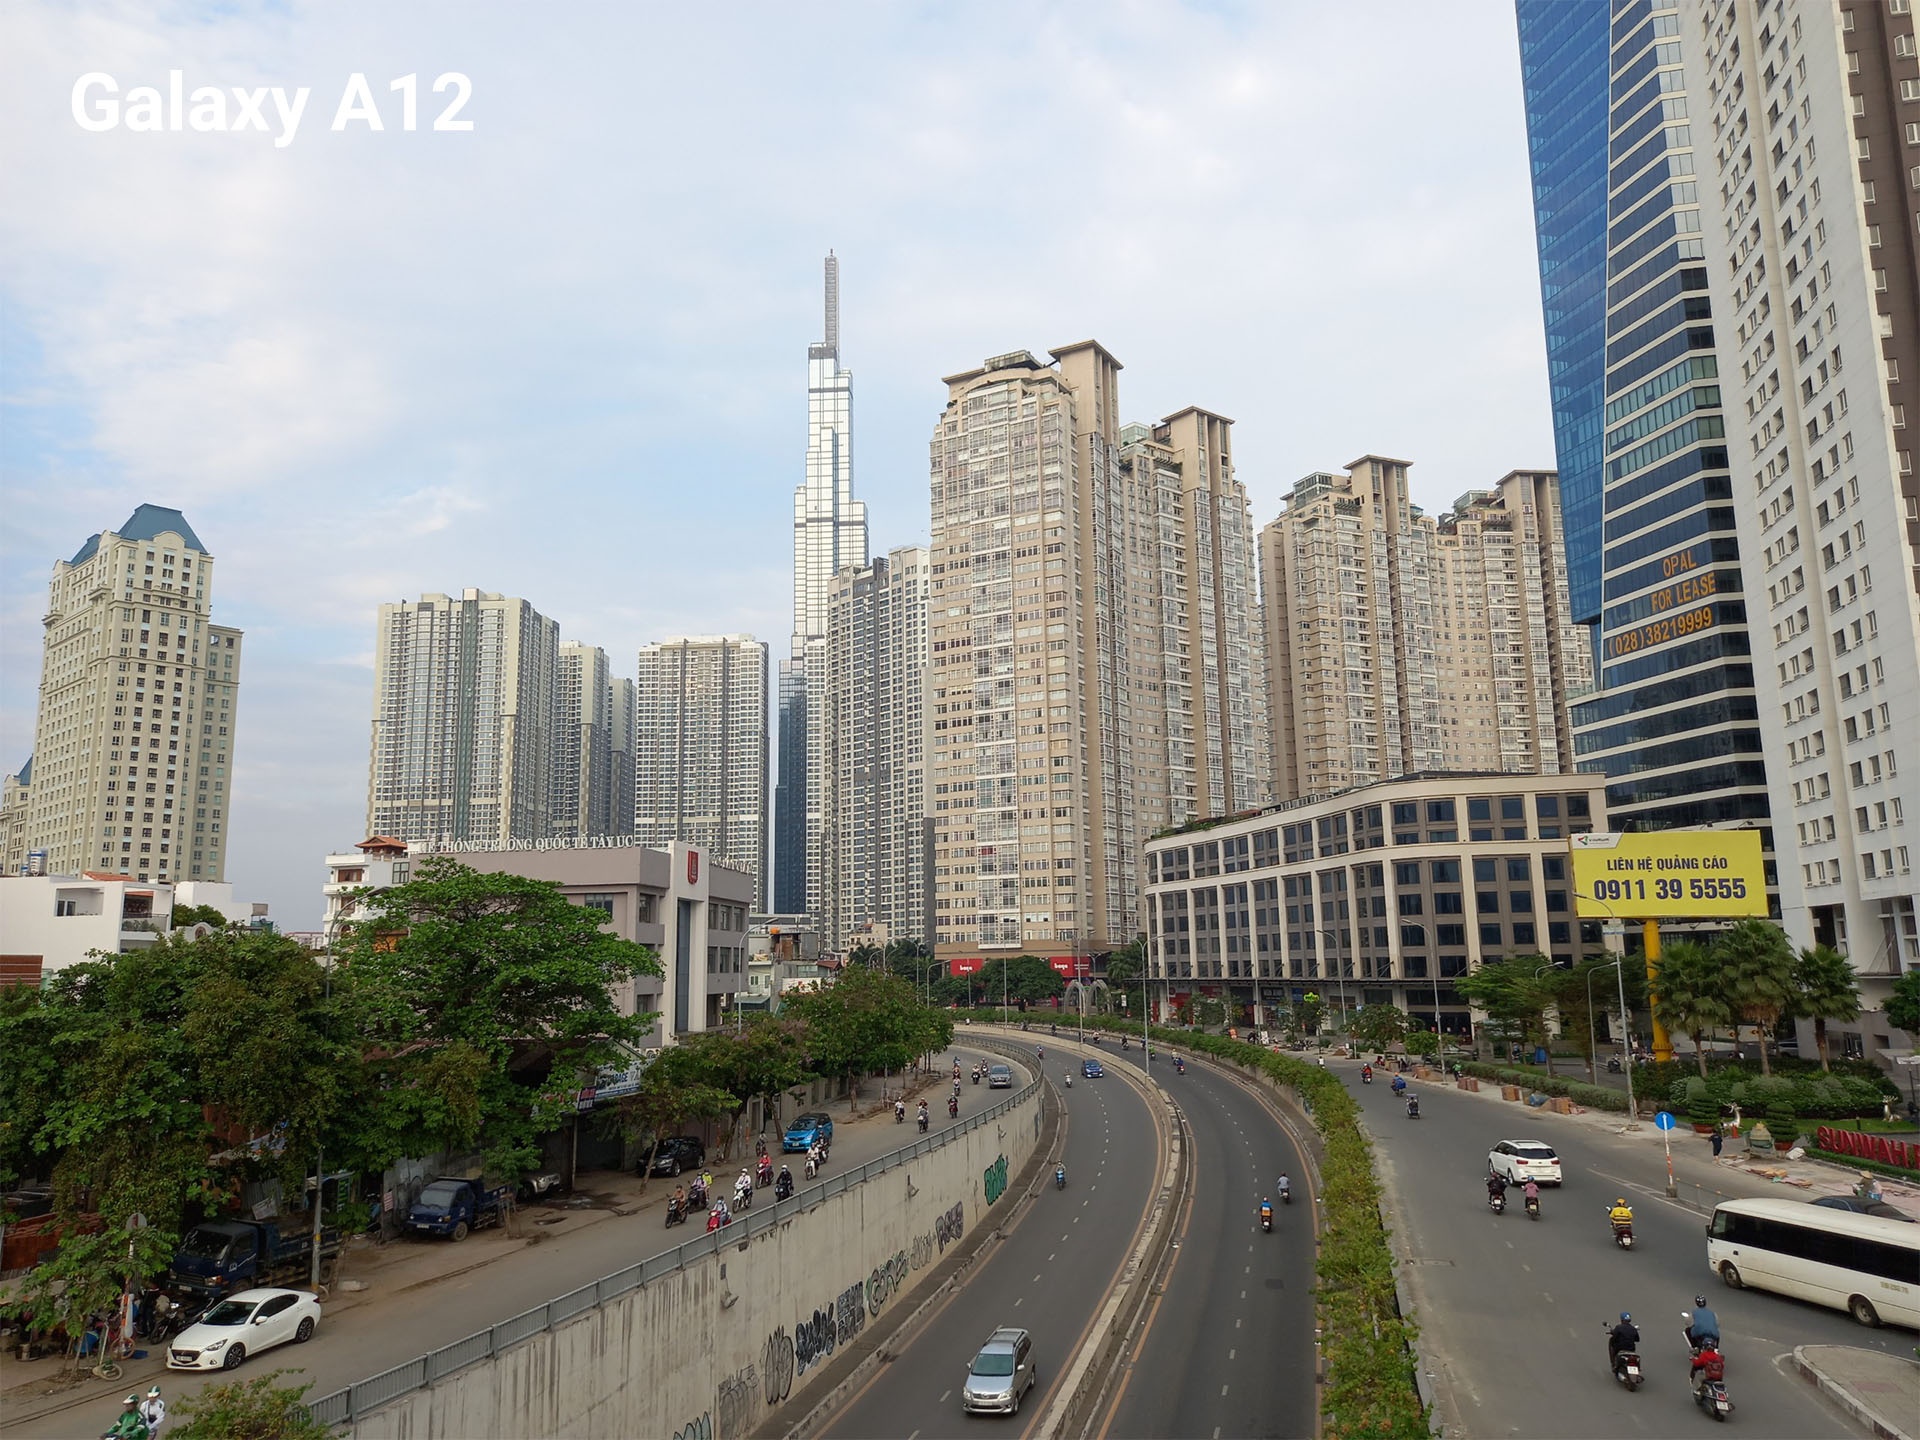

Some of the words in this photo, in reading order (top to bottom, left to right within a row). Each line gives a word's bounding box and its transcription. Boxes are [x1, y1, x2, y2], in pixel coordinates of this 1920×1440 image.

[1663, 550, 1697, 577] OPAL
[1651, 589, 1673, 612] FOR
[1676, 572, 1716, 604] LEASE
[1607, 857, 1634, 871] LIÊN
[1637, 856, 1653, 872] HỆ
[1657, 854, 1699, 871] QUẢNG
[1702, 855, 1728, 870] CÁO
[1593, 879, 1646, 900] 0911
[1655, 878, 1683, 900] 39
[1690, 878, 1747, 899] 5555
[1817, 1125, 1911, 1169] SUNWAH
